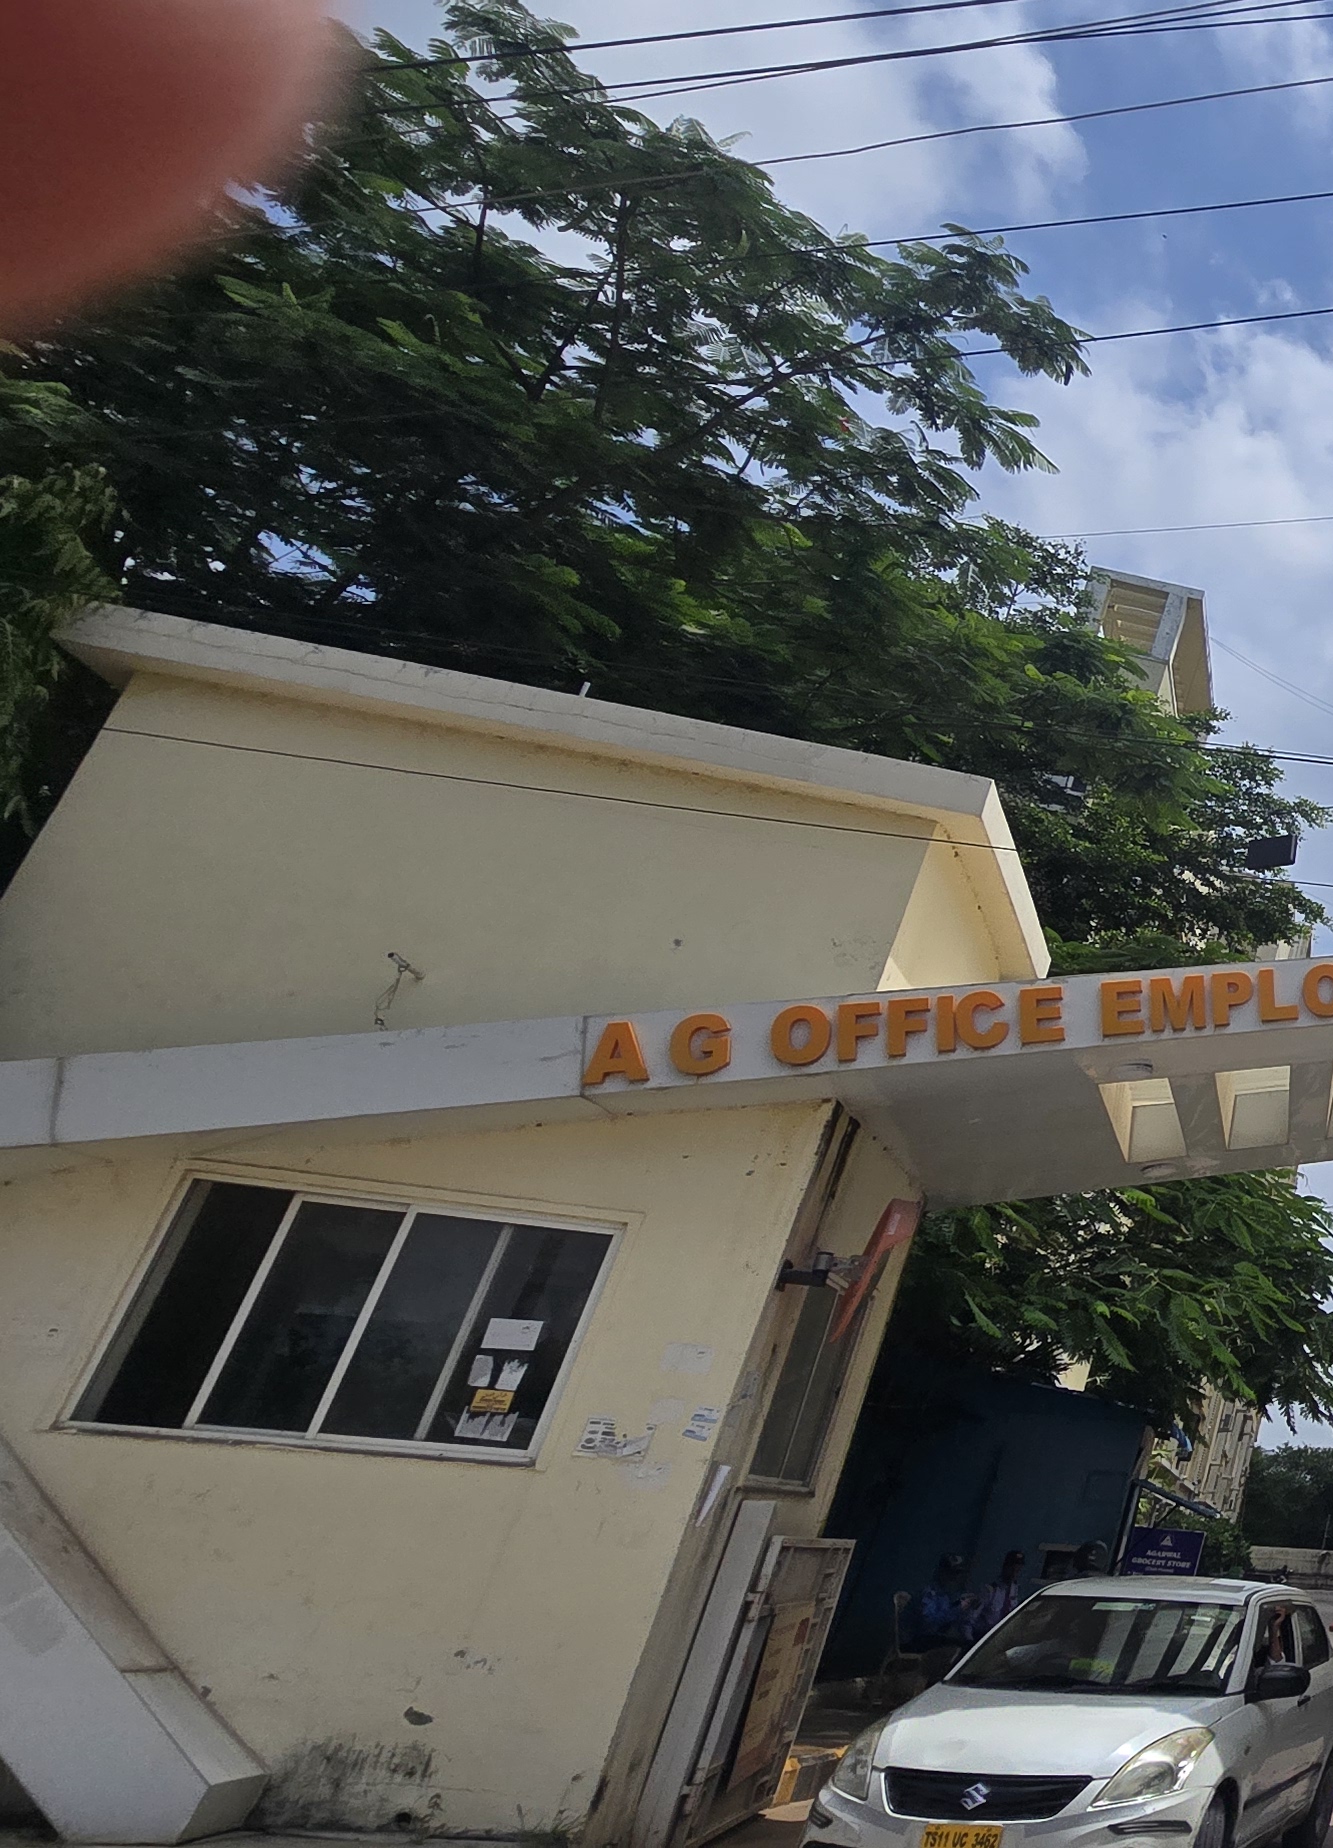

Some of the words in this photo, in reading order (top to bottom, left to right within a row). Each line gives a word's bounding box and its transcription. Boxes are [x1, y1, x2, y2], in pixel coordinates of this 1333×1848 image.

[582, 1021, 649, 1085] A
[669, 1013, 731, 1076] G
[769, 986, 1066, 1066] OFFICE
[1166, 1560, 1191, 1568] STORE
[924, 1831, 950, 1847] TS11
[952, 1831, 969, 1848] UC
